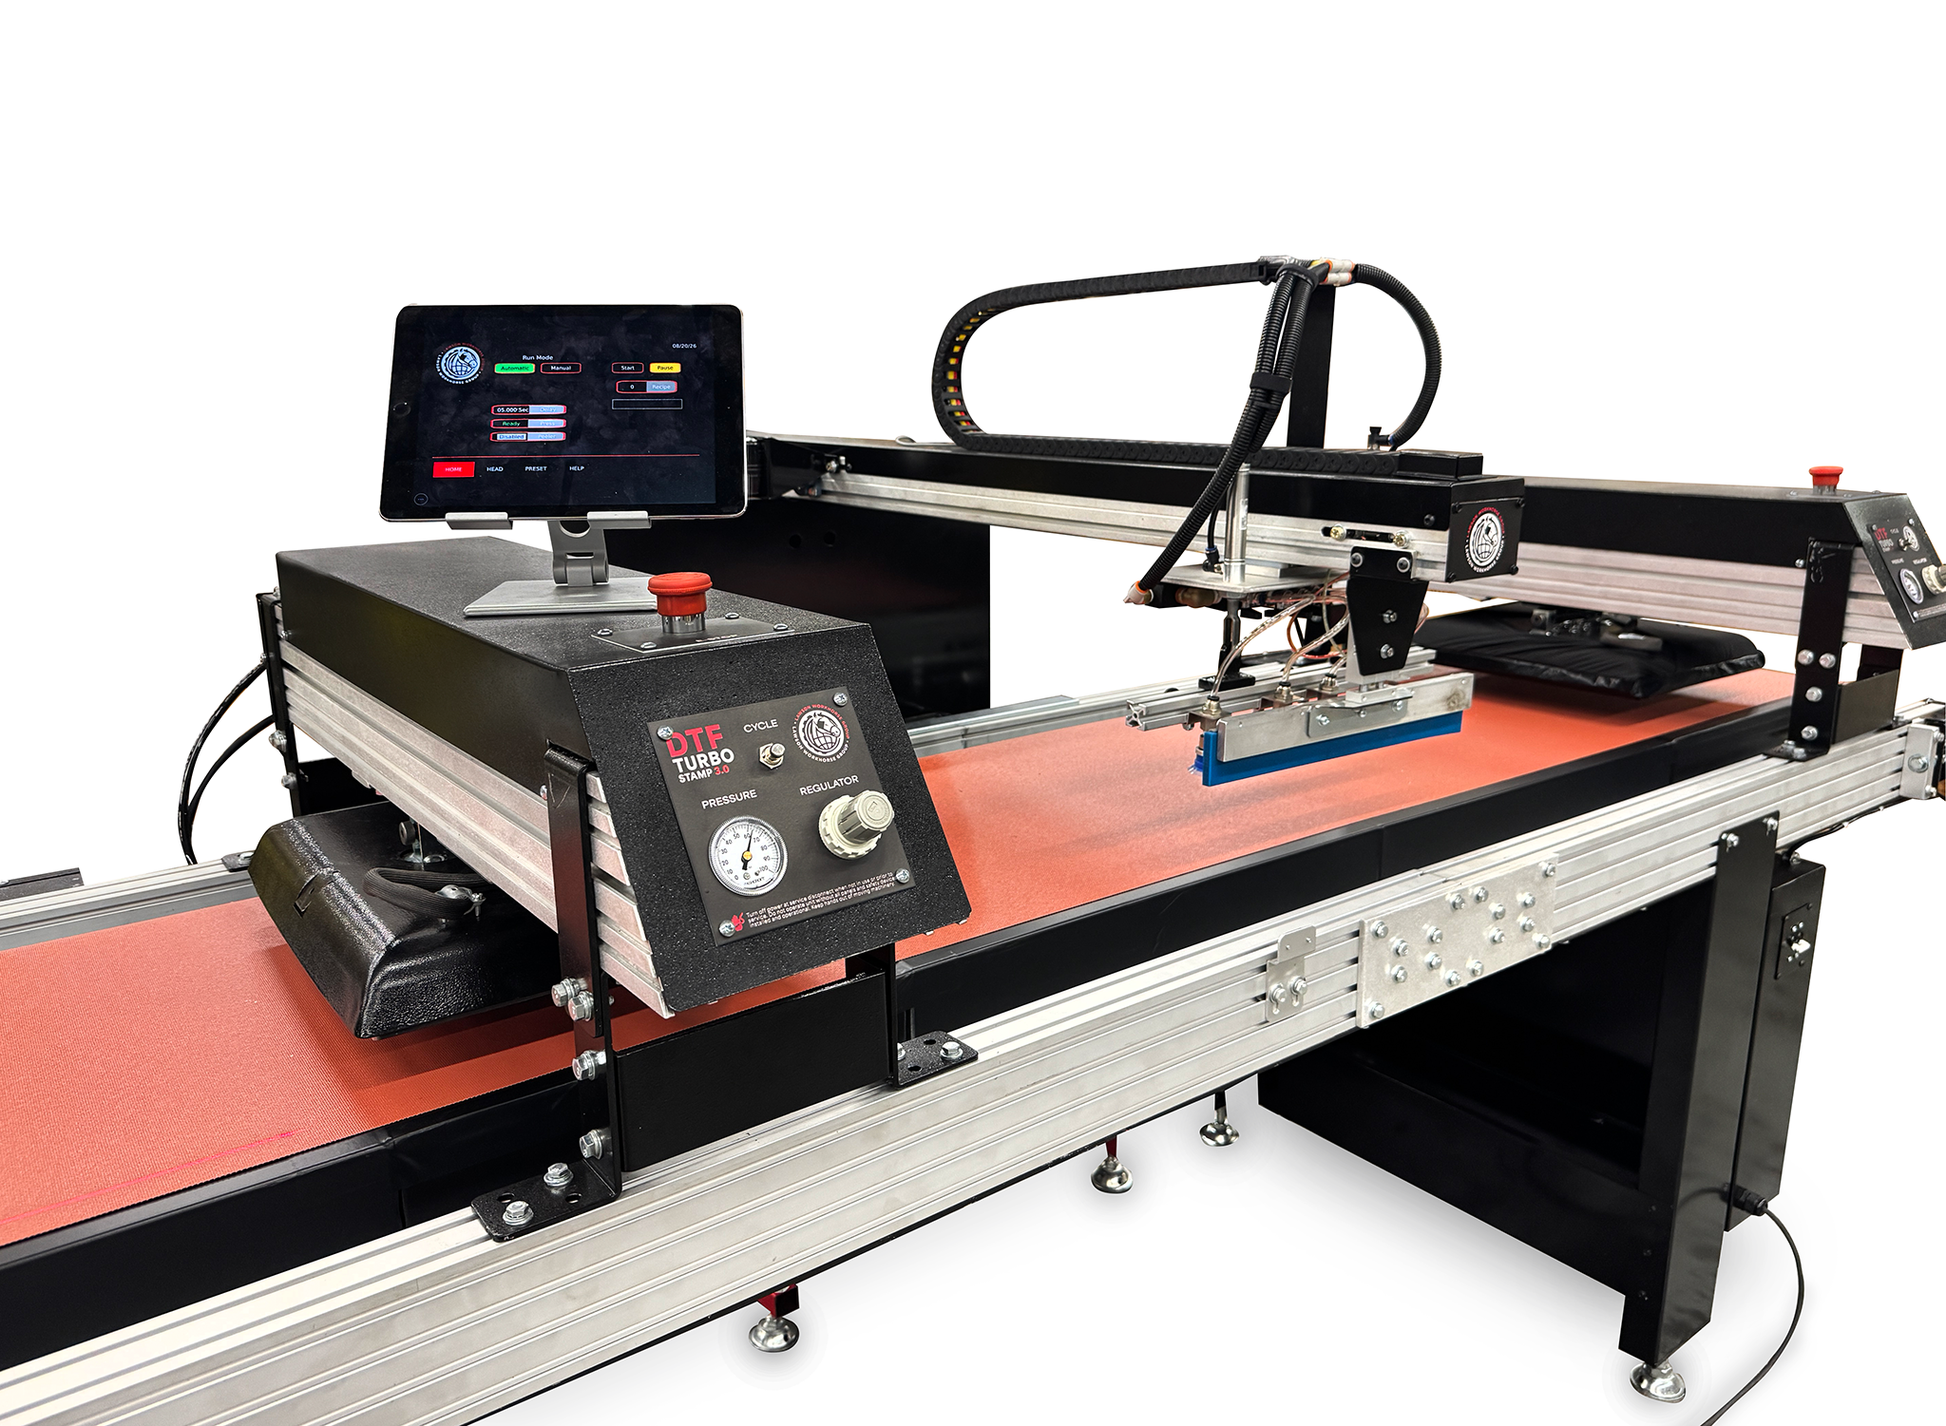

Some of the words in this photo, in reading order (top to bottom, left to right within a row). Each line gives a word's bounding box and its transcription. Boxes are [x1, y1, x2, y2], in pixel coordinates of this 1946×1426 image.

[743, 719, 779, 733] CYCLE
[666, 724, 723, 758] DTF
[672, 747, 735, 773] TURBO
[803, 749, 837, 763] WORKHORSE
[678, 768, 713, 784] STAMP
[713, 764, 730, 776] 3.0
[799, 775, 859, 796] REGULATOR
[701, 789, 758, 809] PRESSURE
[720, 847, 728, 855] 30
[766, 903, 782, 911] power
[789, 896, 807, 905] service
[807, 888, 834, 900] disconnect
[834, 884, 847, 892] when
[785, 902, 805, 912] operate
[815, 894, 834, 903] without
[865, 881, 879, 889] safety
[811, 902, 824, 910] Keep
[824, 898, 838, 906] hands
[853, 889, 870, 898] moving
